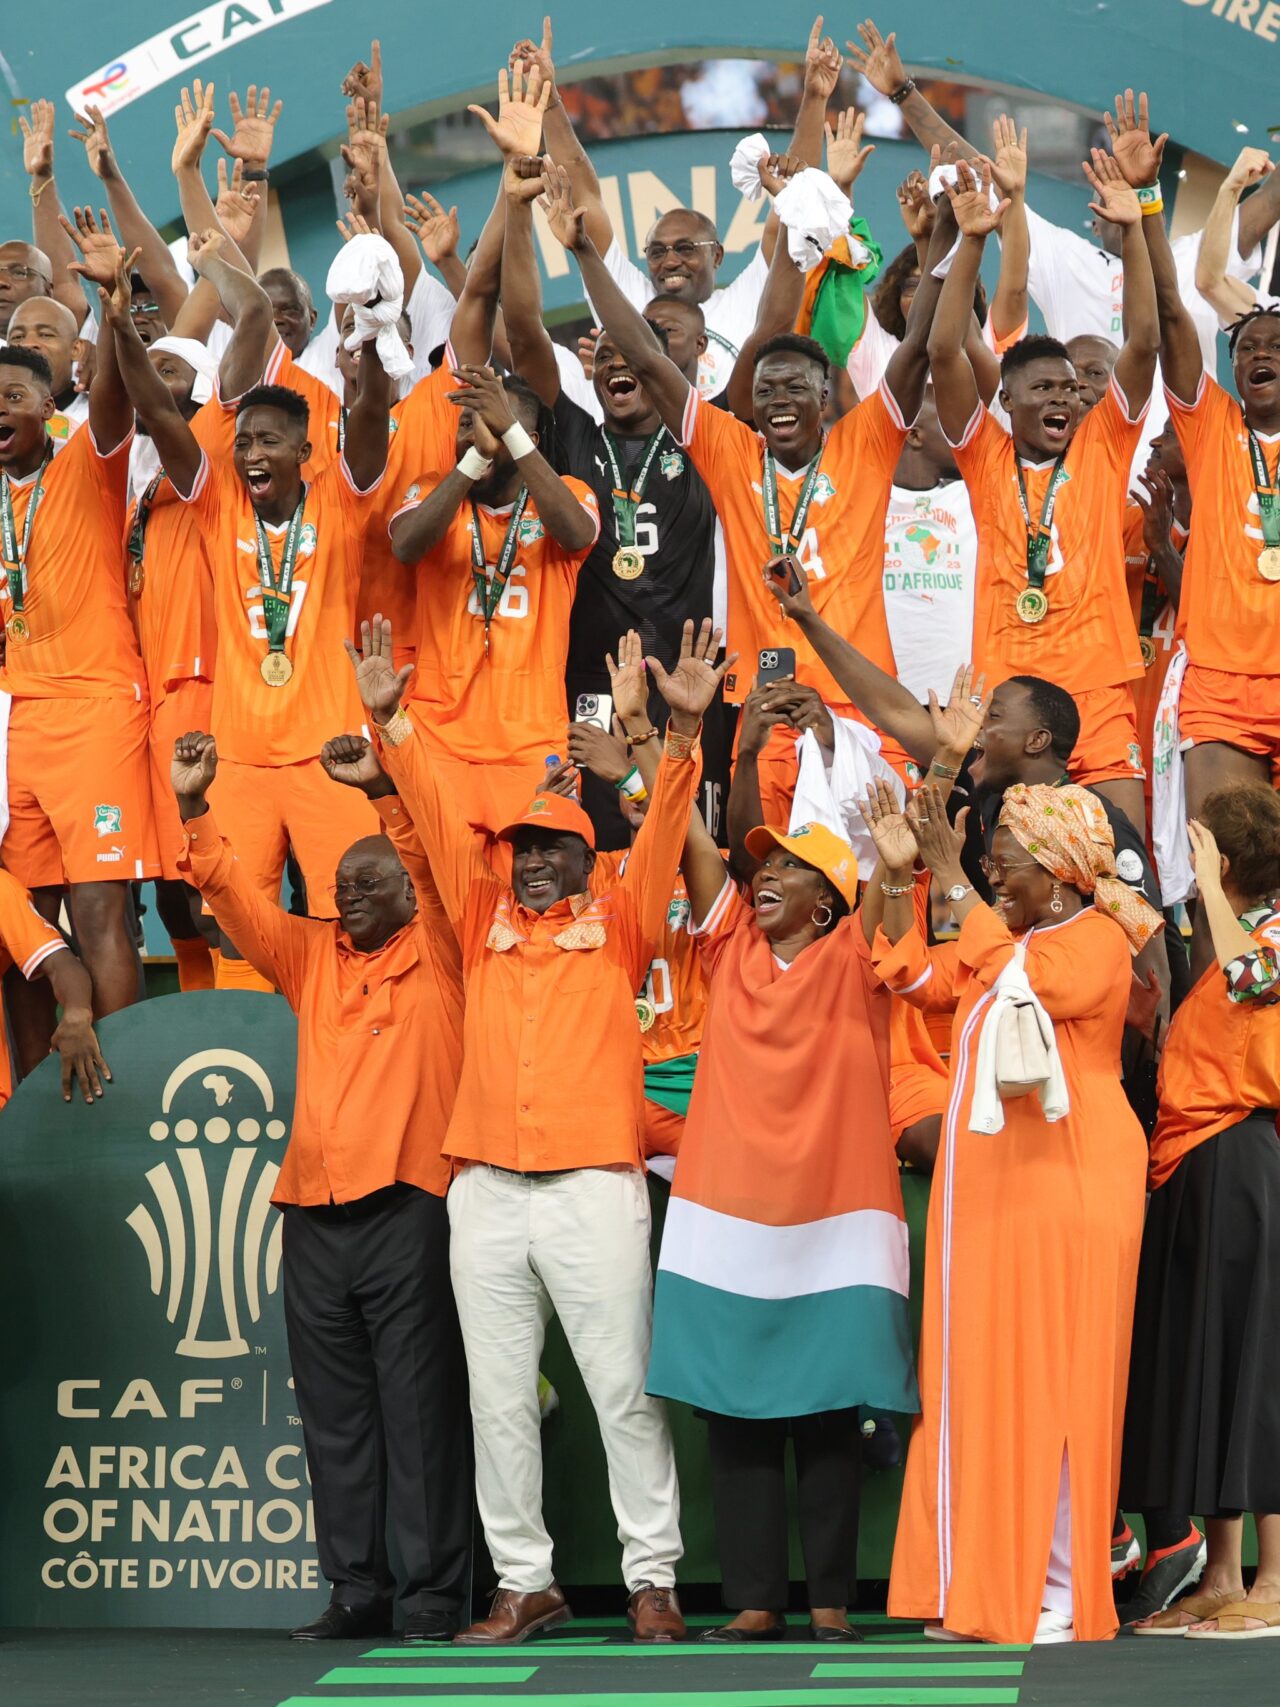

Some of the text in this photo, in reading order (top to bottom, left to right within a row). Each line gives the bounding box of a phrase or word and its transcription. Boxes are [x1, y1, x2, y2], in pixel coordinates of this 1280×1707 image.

[801, 487, 811, 507] AFRICA
[507, 525, 517, 543] AFRICA
[885, 560, 960, 569] 20 23
[44, 1445, 249, 1489] AFRICA
[43, 1498, 317, 1543] OF NATIO
[41, 1551, 319, 1590] CÔTE D'IVOIRE
